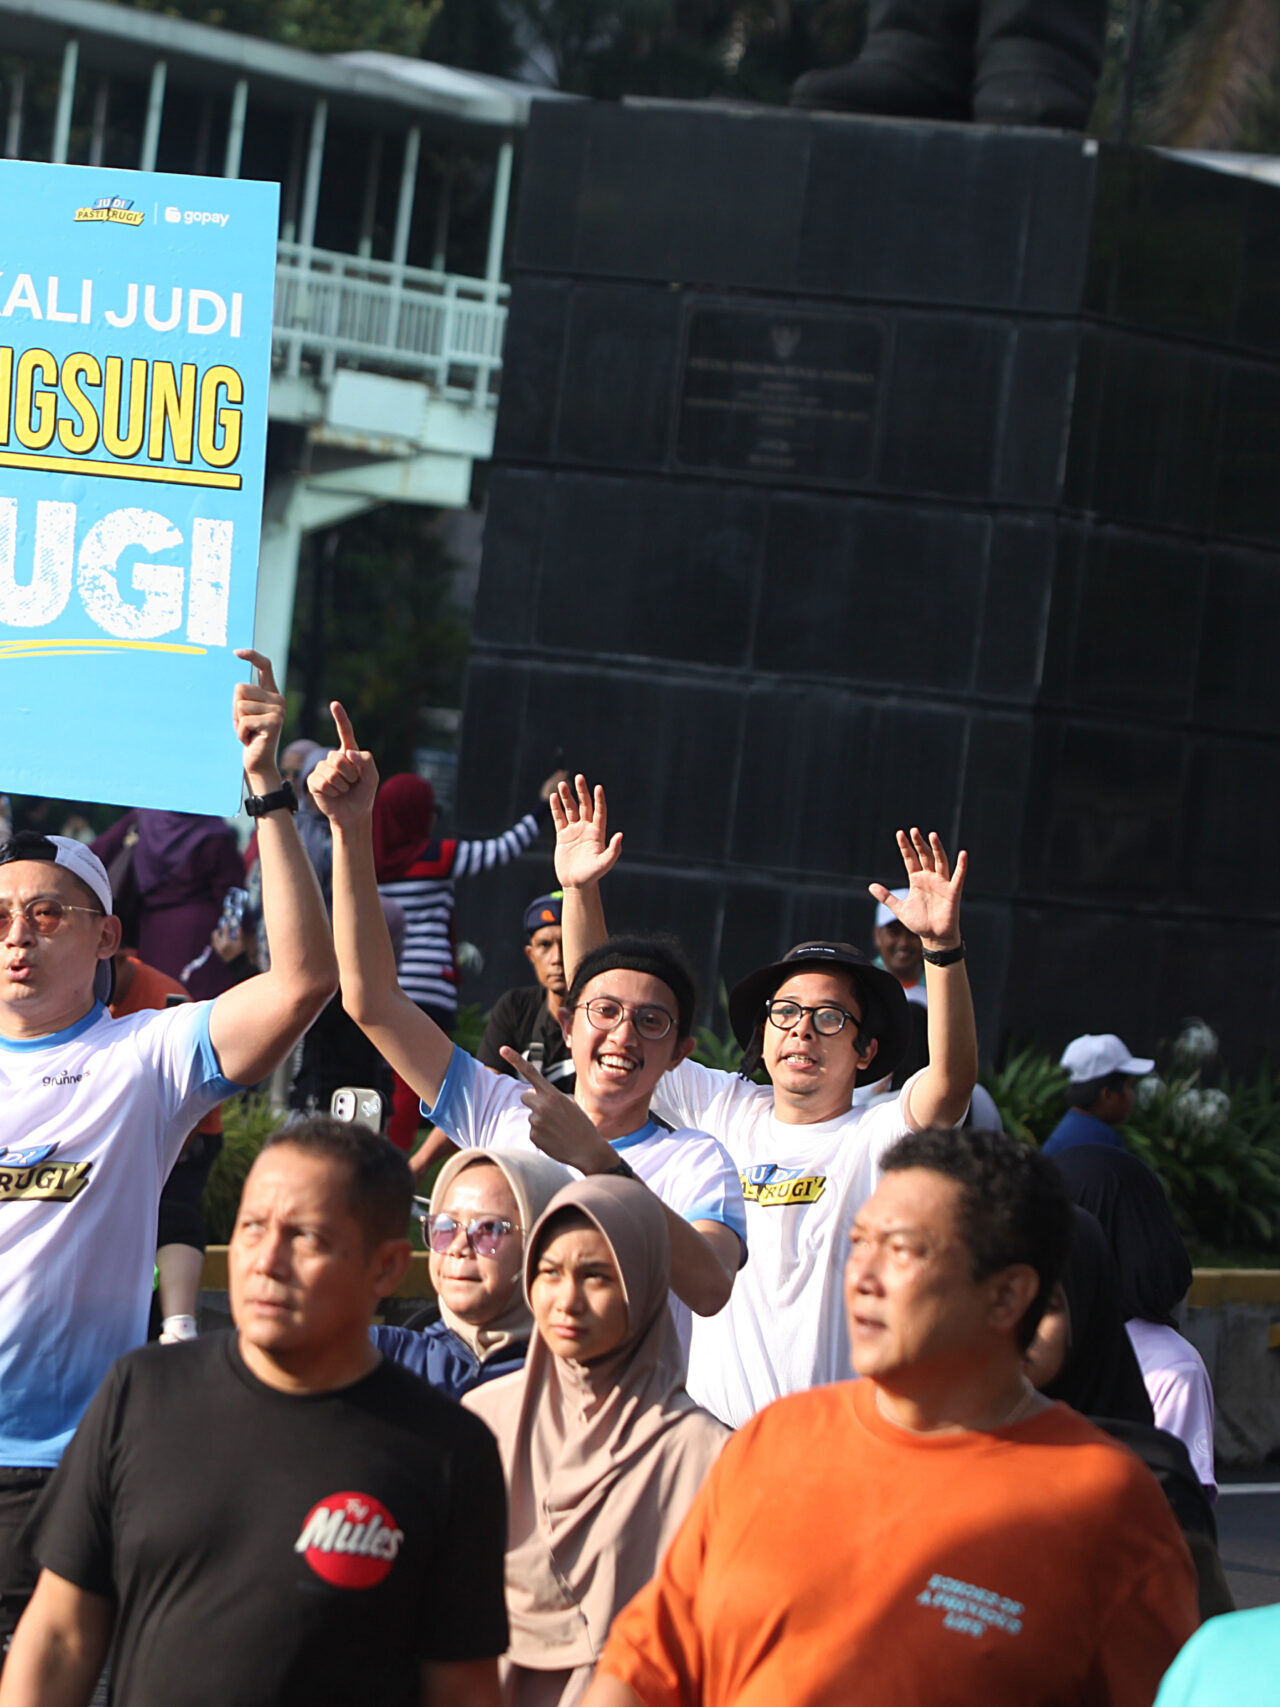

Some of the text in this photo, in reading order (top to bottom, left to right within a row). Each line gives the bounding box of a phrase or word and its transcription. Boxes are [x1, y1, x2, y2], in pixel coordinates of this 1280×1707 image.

[96, 198, 126, 209] JUDI
[77, 209, 138, 223] PASTI RUGI
[183, 209, 230, 228] gopay
[104, 282, 243, 339] JUDI
[764, 1180, 814, 1200] RUGI
[294, 1506, 404, 1560] Mules
